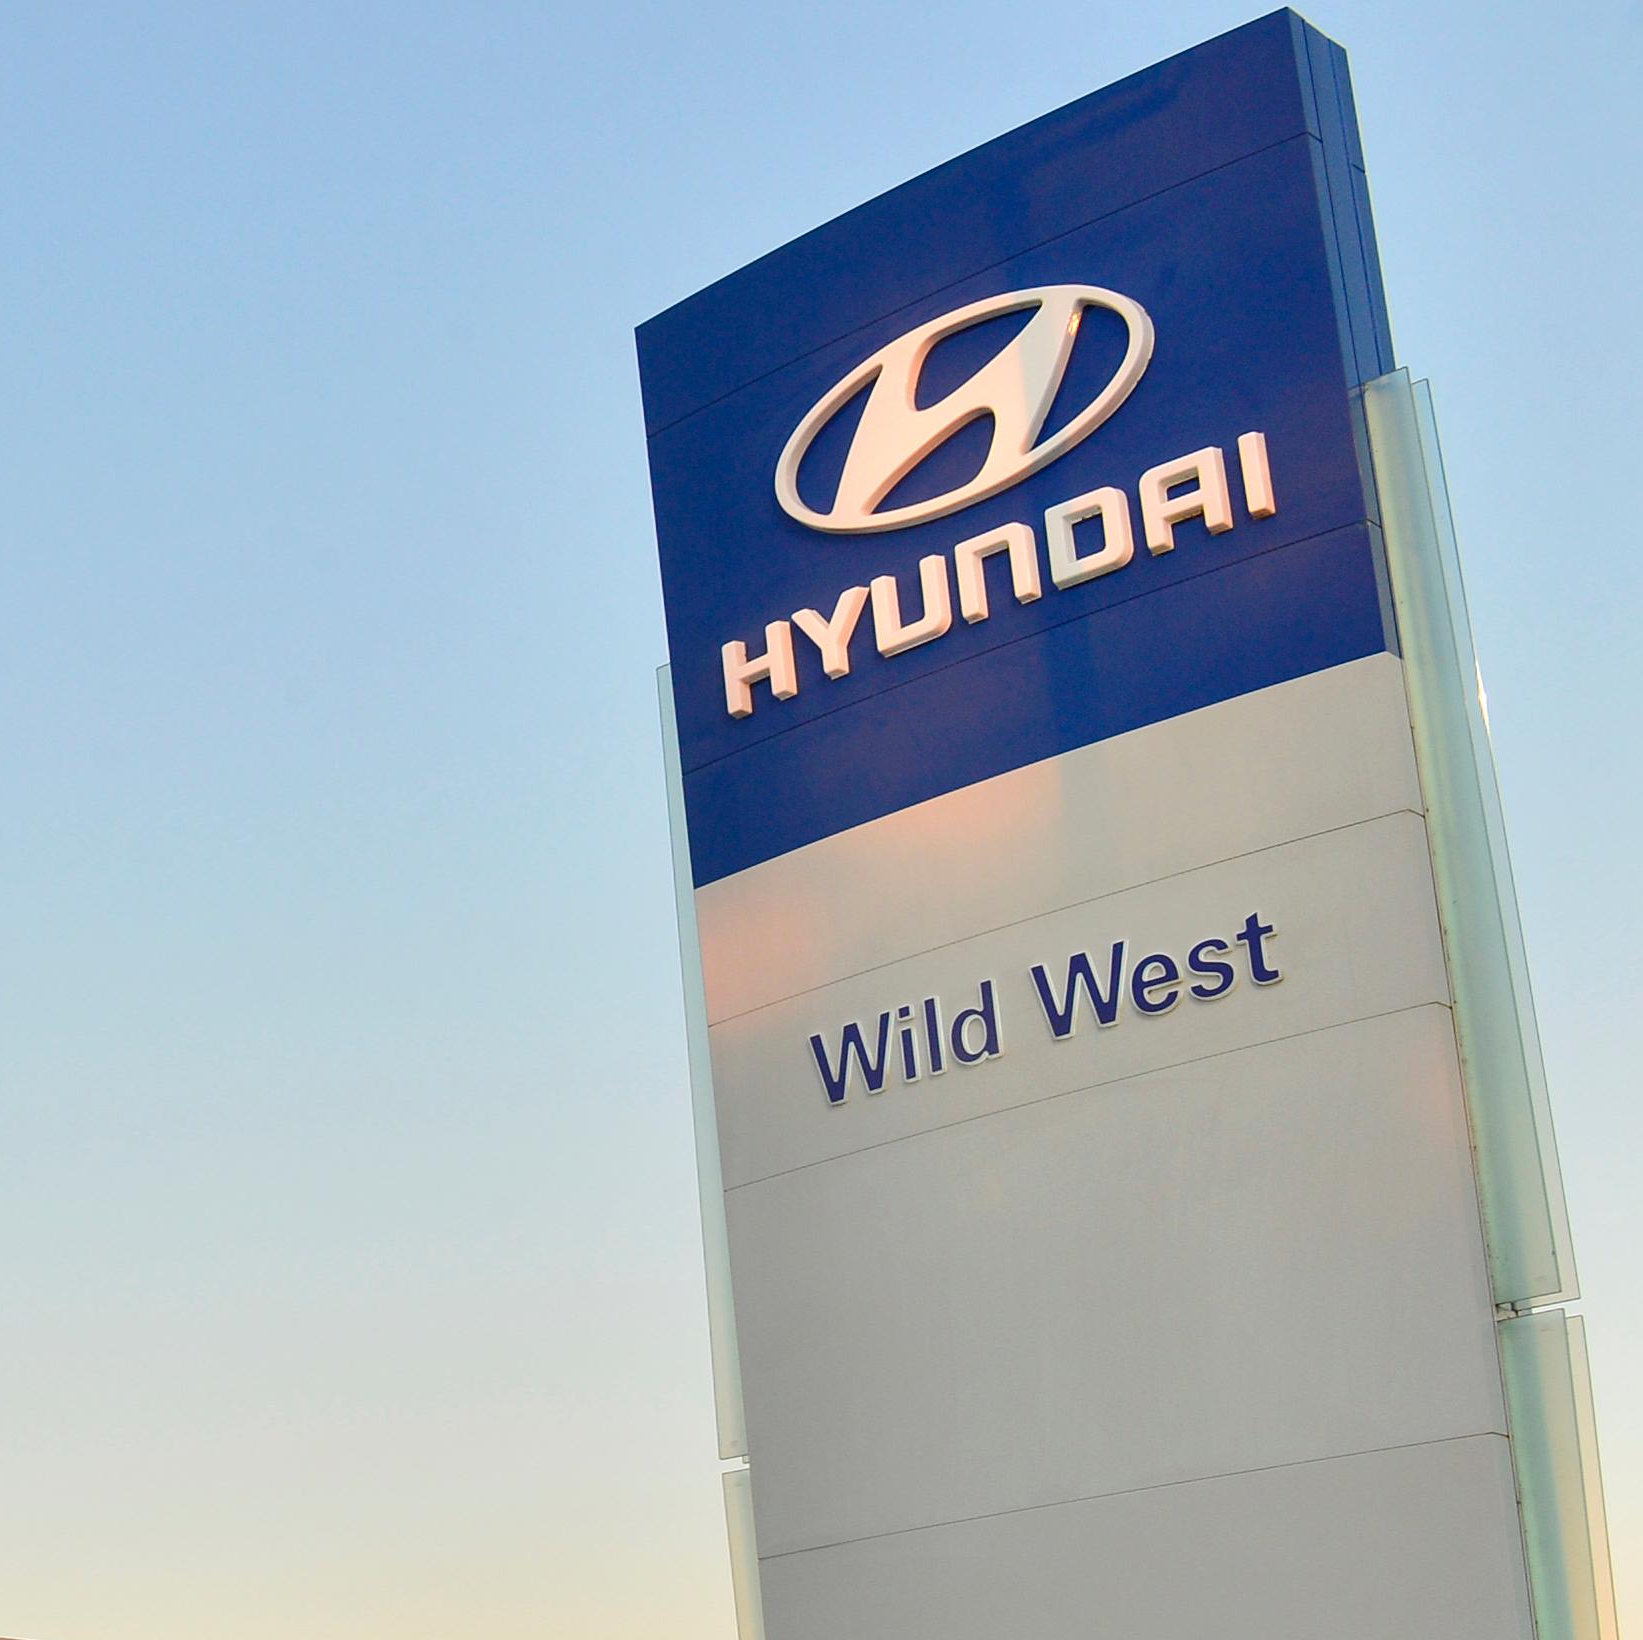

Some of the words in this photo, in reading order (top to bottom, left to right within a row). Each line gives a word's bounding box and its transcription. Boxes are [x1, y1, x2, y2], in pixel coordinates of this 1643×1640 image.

[721, 431, 1276, 719] HYUNDAI
[808, 979, 1003, 1106] Wild
[1031, 911, 1282, 1041] West
